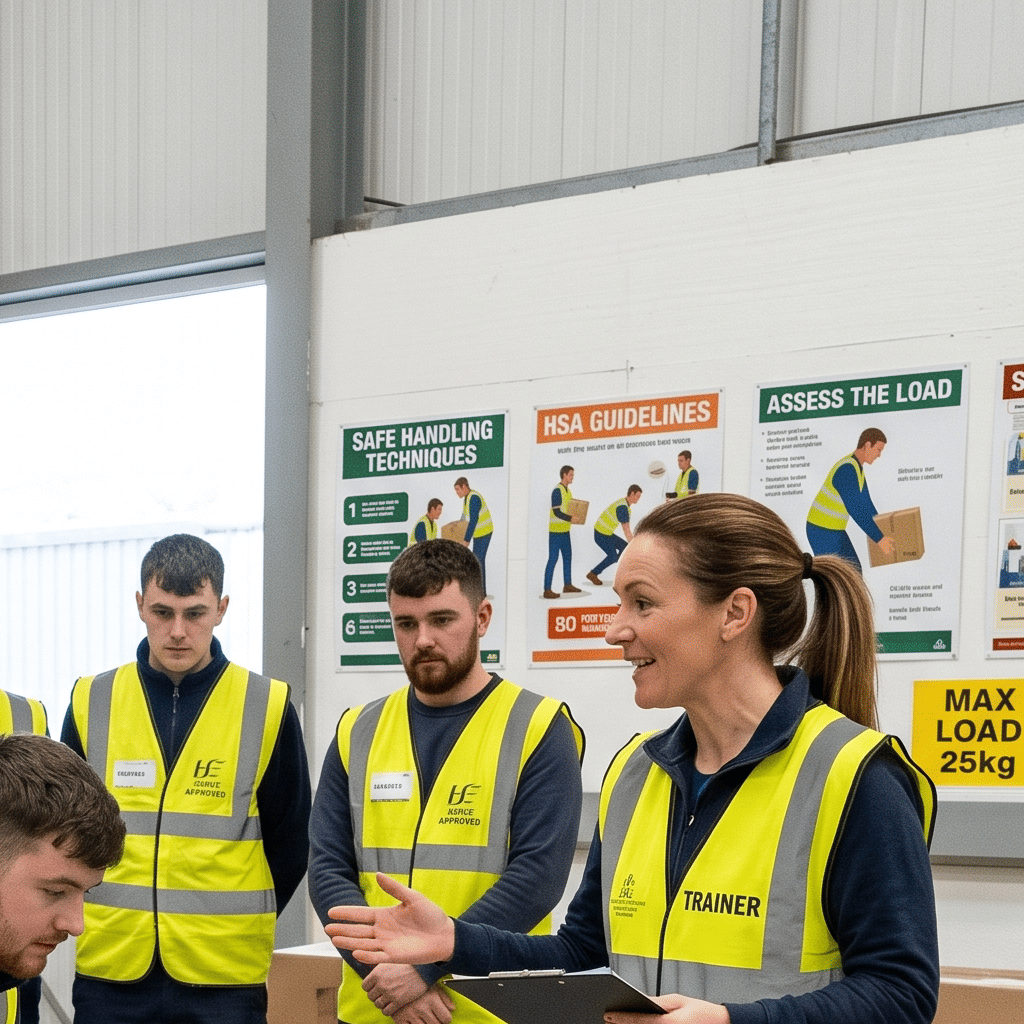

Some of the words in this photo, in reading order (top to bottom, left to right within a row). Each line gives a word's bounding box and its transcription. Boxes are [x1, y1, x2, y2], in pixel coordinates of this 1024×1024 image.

[766, 388, 844, 415] ASSESS
[850, 384, 889, 407] THE
[896, 378, 952, 403] LOAD
[544, 413, 583, 436] HSA
[590, 400, 711, 432] GUIDELINES
[352, 429, 396, 451] SAFE
[401, 420, 493, 447] HANDLING
[366, 444, 477, 472] TECHNIQUES
[348, 502, 356, 518] 1
[347, 542, 357, 557] 2
[346, 581, 357, 596] 3
[345, 619, 356, 635] 6
[555, 615, 577, 632] 80
[945, 688, 1016, 711] MAX
[936, 719, 1022, 742] LOAD
[940, 750, 1015, 779] 25kg
[438, 817, 481, 826] APPROVED
[684, 890, 761, 917] TRAINER
